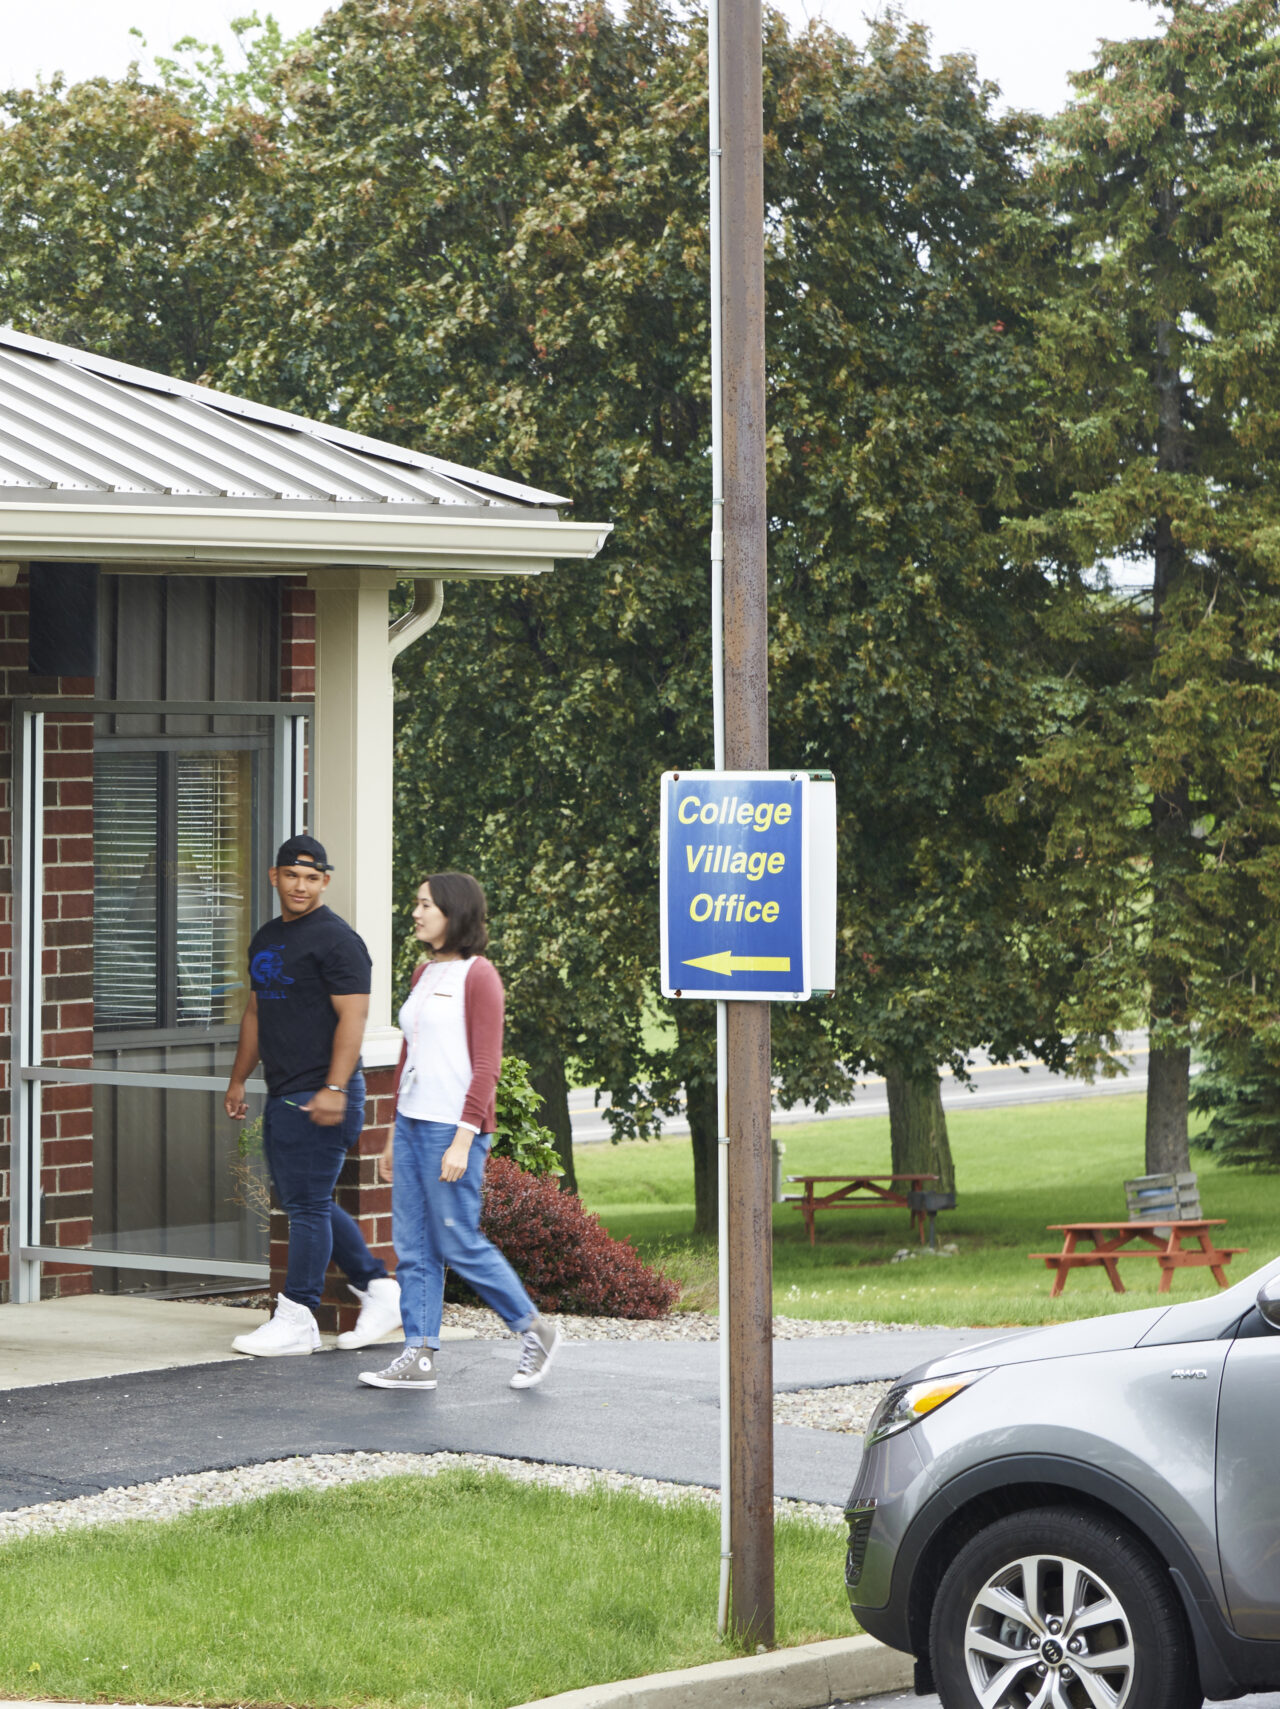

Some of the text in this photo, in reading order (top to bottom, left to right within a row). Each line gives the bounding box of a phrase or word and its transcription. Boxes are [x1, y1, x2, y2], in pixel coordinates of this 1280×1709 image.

[678, 796, 792, 832] College
[686, 845, 785, 881] Village
[689, 893, 780, 923] Office
[1171, 1369, 1207, 1379] AWD
[1045, 1642, 1059, 1662] KIA
